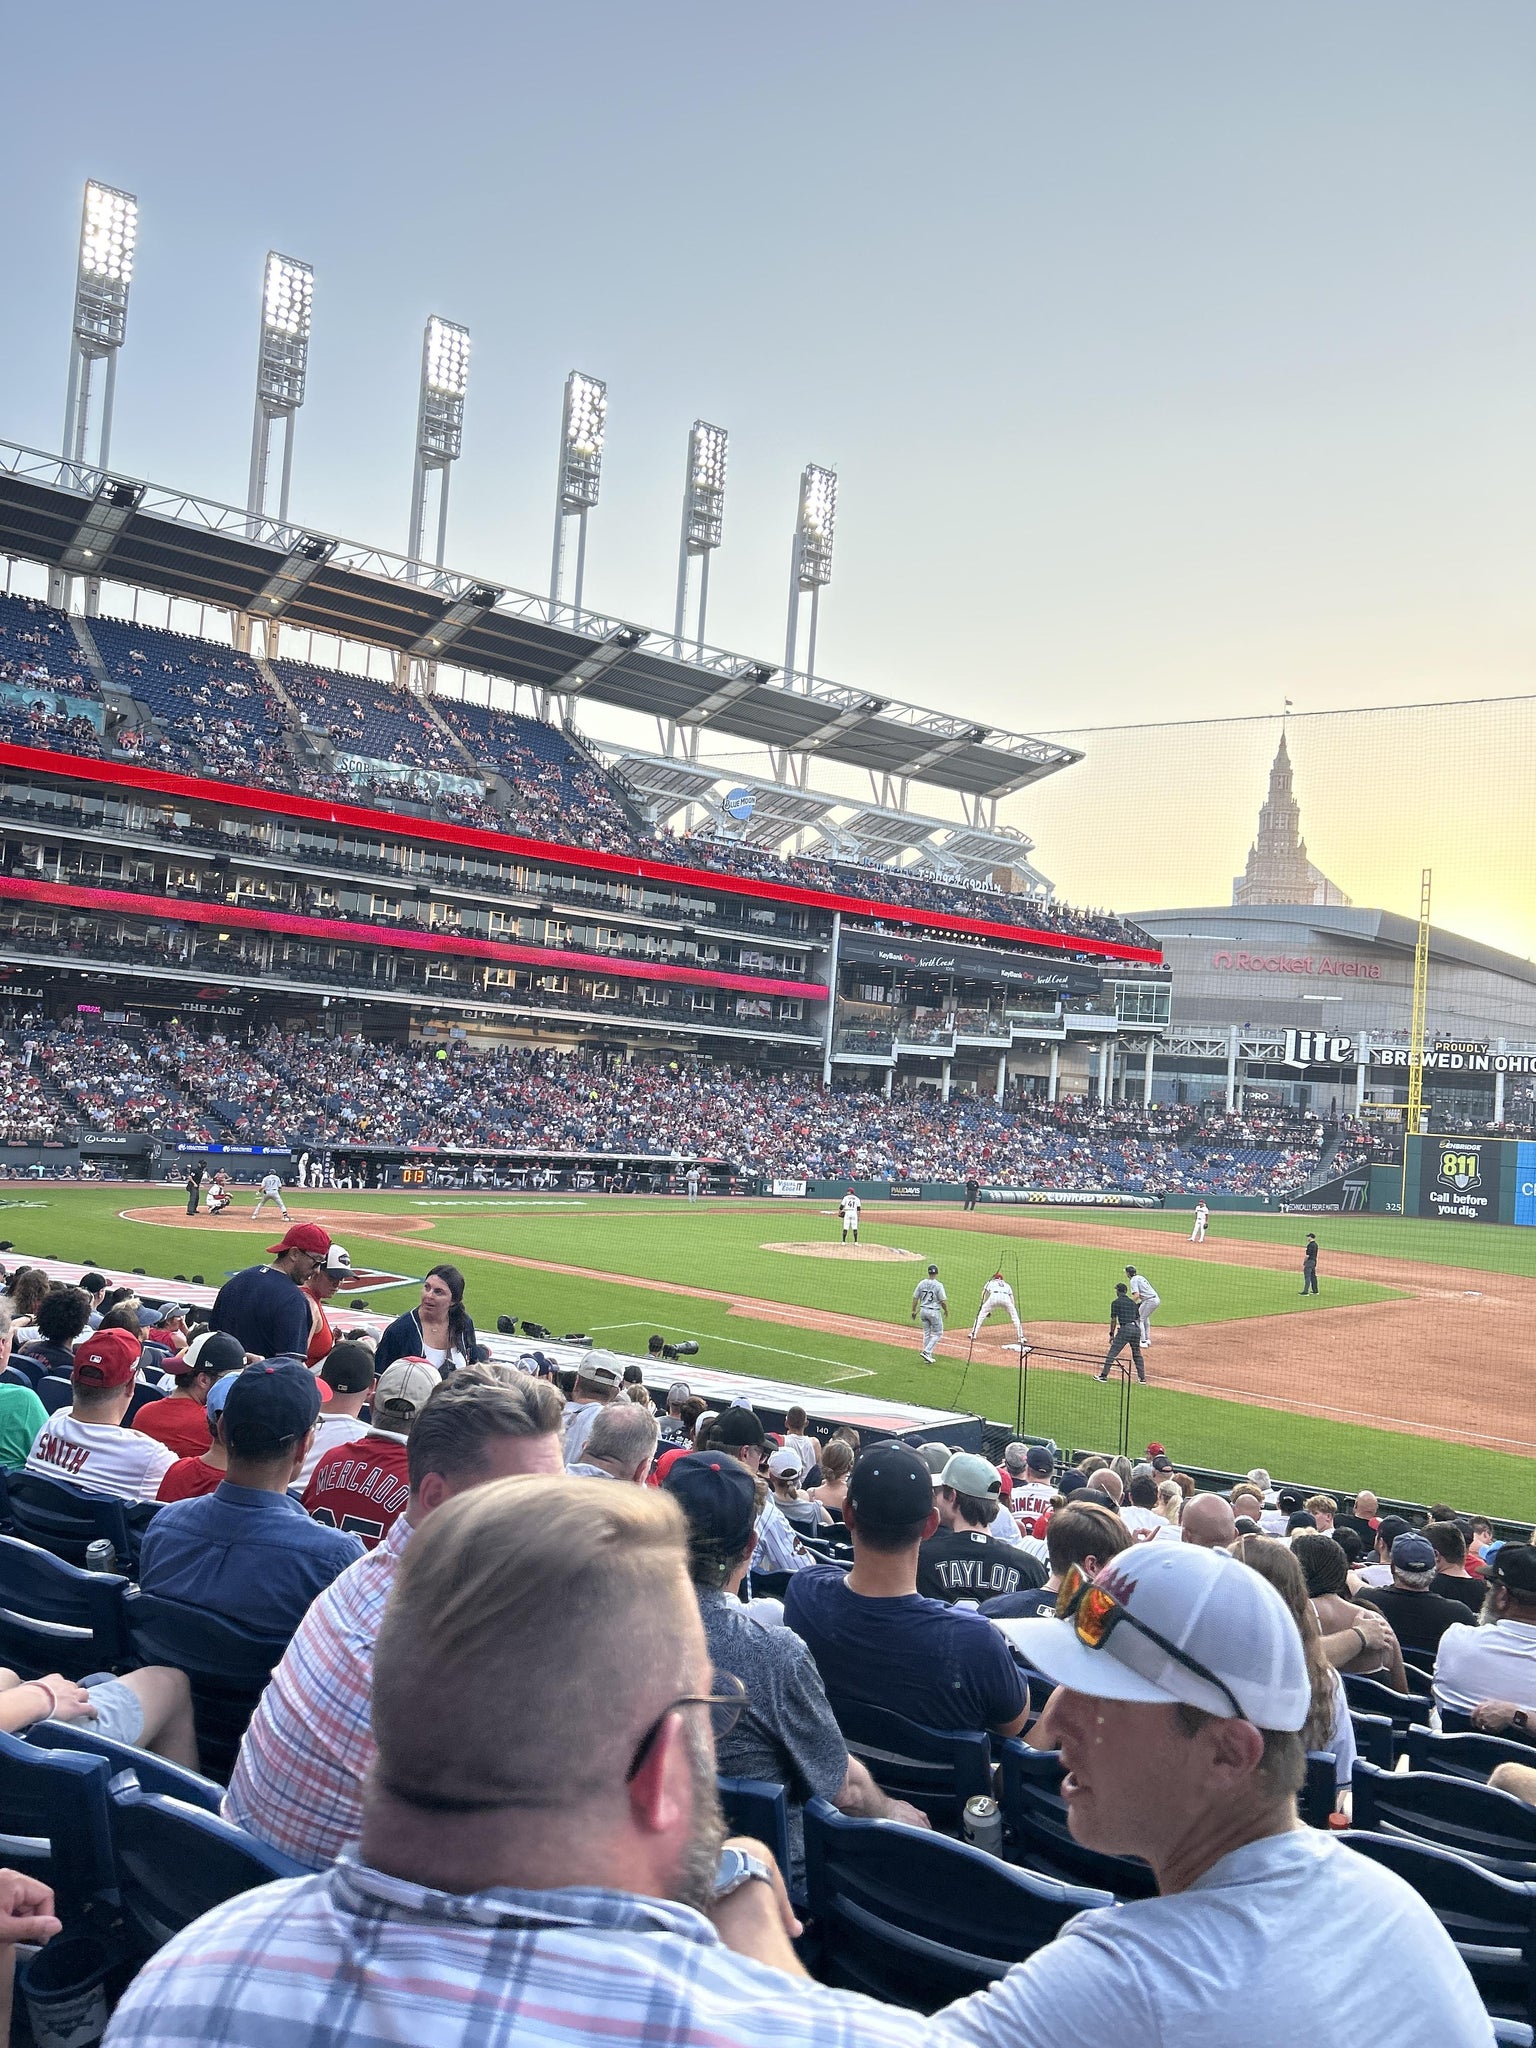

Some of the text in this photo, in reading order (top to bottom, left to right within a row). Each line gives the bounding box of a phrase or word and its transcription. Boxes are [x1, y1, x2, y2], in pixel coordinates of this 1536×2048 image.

[725, 797, 756, 810] BLUE MOON
[878, 951, 904, 961] KeyBank
[1235, 951, 1382, 978] Rocket Arena
[1000, 969, 1023, 979] KeyBank
[181, 1003, 208, 1013] THE
[1280, 1028, 1353, 1070] Lite
[1435, 1041, 1489, 1054] PROUDLY
[1381, 1049, 1466, 1070] BREWED
[1468, 1053, 1490, 1071] IN
[1442, 1153, 1476, 1177] 811
[847, 1200, 856, 1209] 41
[1429, 1191, 1488, 1206] Call before
[1385, 1202, 1401, 1212] 325
[1438, 1205, 1479, 1218] you dig.
[921, 1290, 934, 1302] 73
[816, 1426, 829, 1435] 140
[36, 1433, 91, 1475] SMITH
[316, 1460, 410, 1513] MERCADO
[935, 1560, 1020, 1594] TAYLOR
